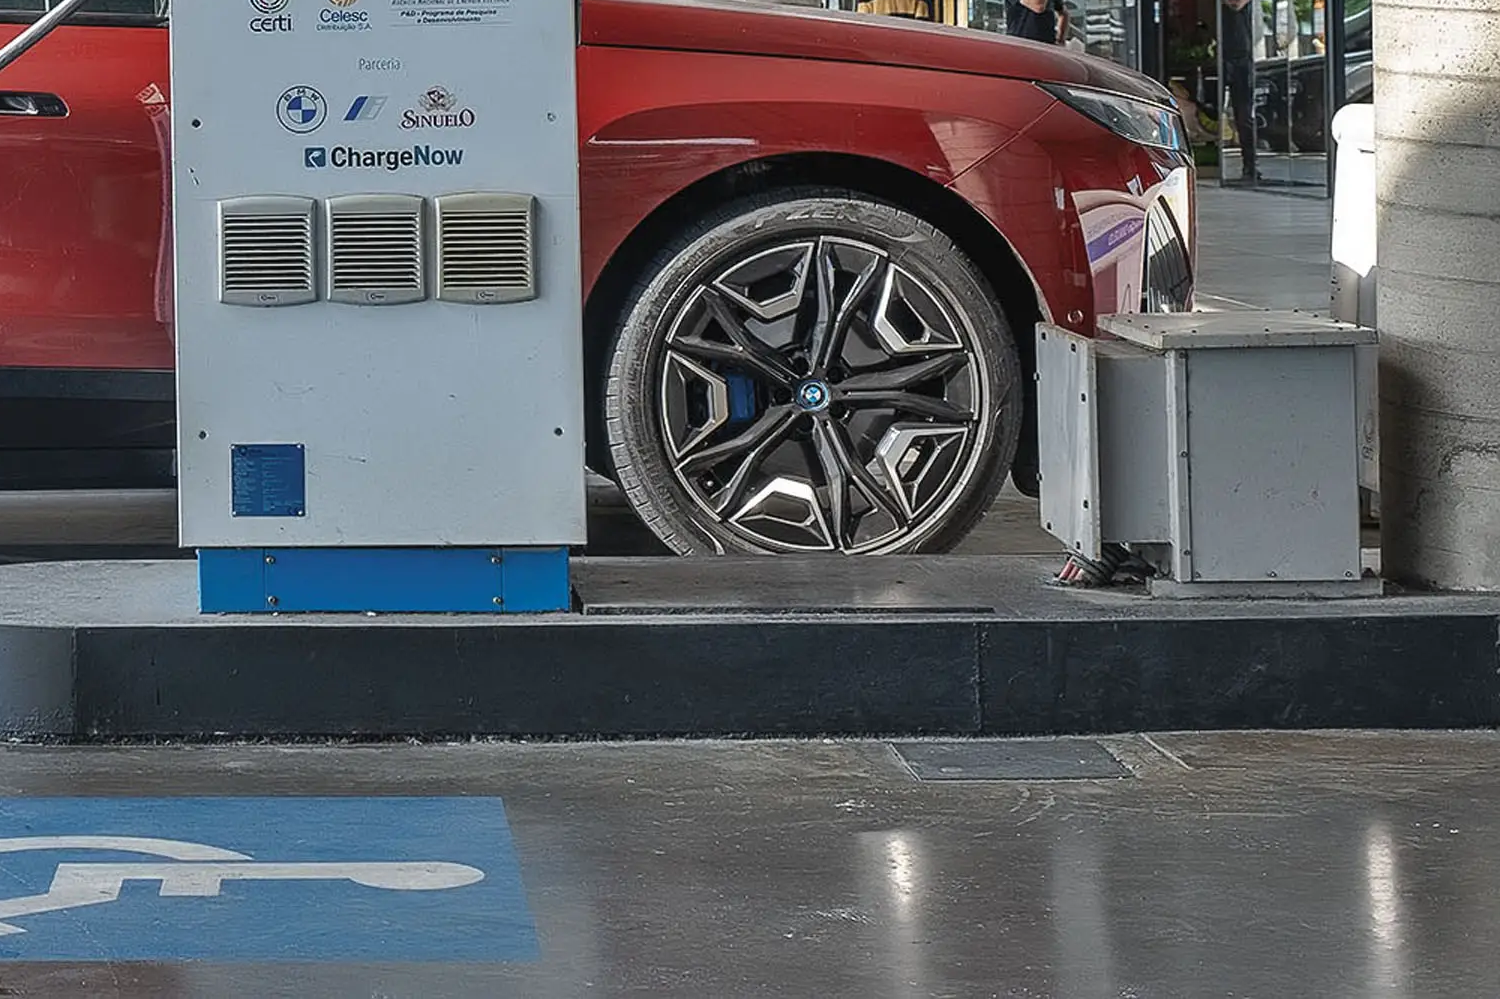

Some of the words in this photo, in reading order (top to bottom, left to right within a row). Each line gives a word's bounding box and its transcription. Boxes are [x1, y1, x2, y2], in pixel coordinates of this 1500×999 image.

[319, 8, 369, 24] Celesc
[359, 58, 401, 71] Parceria
[330, 145, 464, 171] ChargeNow
